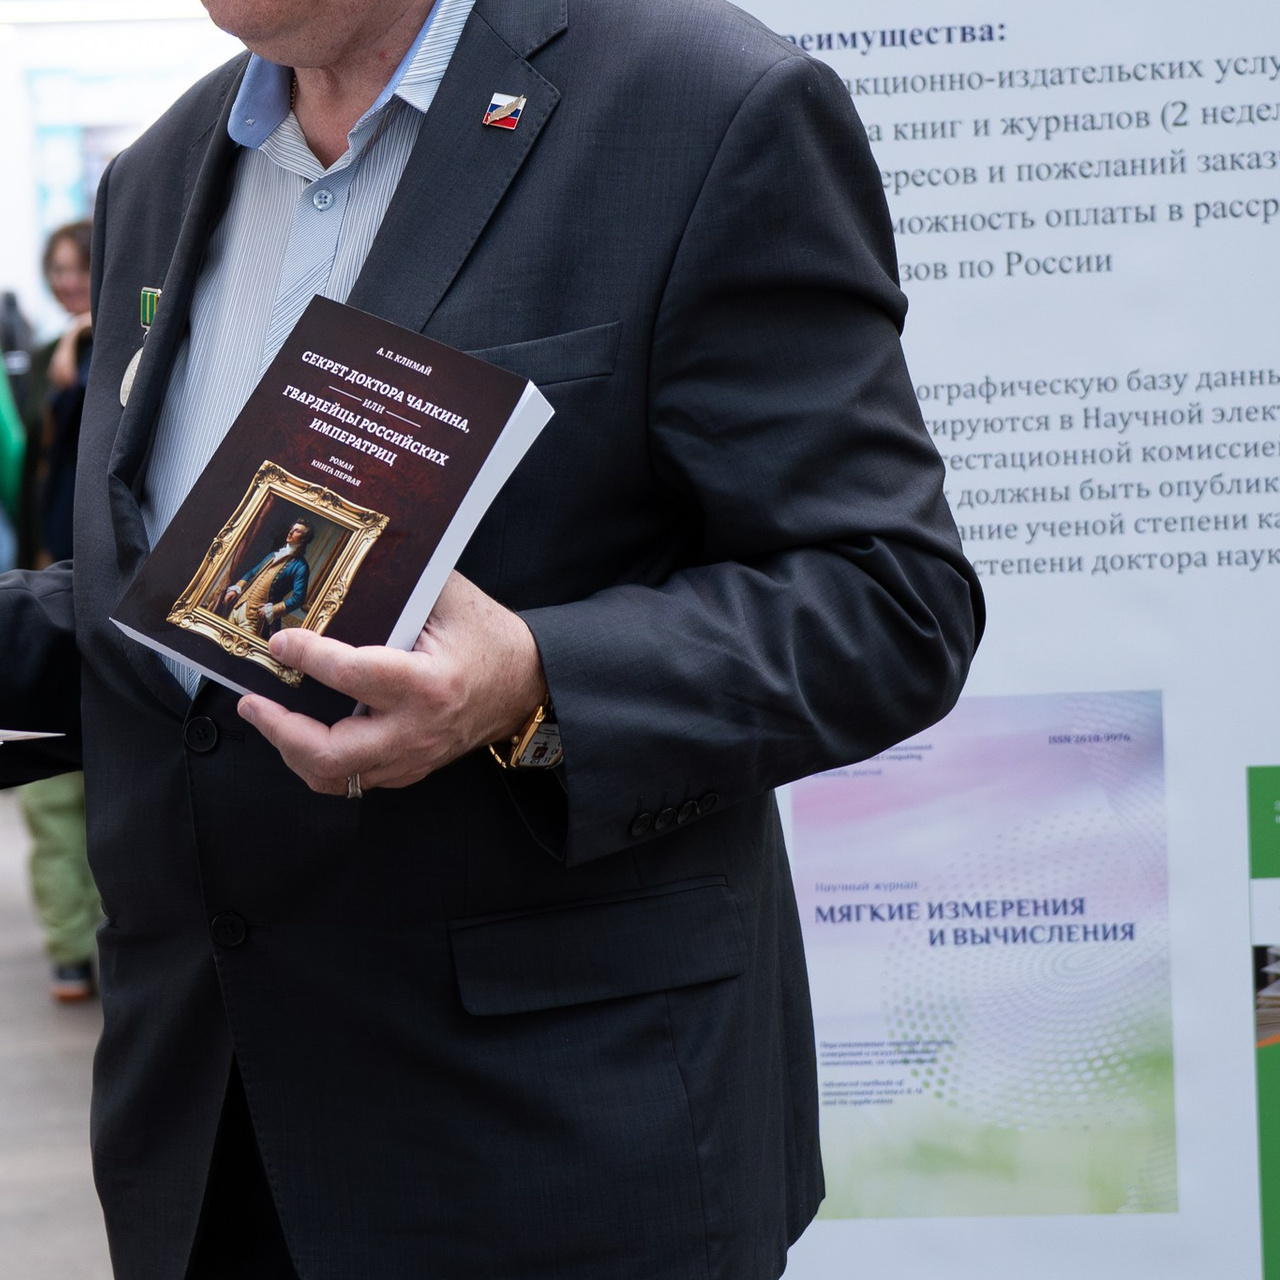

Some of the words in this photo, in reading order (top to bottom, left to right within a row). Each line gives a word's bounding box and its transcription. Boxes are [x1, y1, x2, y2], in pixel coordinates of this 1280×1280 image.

[893, 120, 962, 142] книг
[973, 118, 990, 137] и
[1001, 109, 1150, 141] журналов
[1160, 100, 1188, 134] (2
[989, 165, 1005, 183] и
[1017, 148, 1186, 183] пожеланий
[1197, 149, 1280, 173] заказ
[1045, 202, 1157, 229] оплаты
[1168, 202, 1183, 222] в
[958, 259, 994, 279] по
[1004, 251, 1113, 277] России
[376, 347, 384, 356] А.
[385, 351, 394, 360] П.
[394, 354, 432, 376] КЛИМАЙ
[301, 351, 349, 378] СЕКРЕТ
[345, 370, 404, 403] ДОКТОРА
[406, 394, 470, 434] ЧАЛКИНА,
[916, 375, 1118, 406] ографическую
[1126, 368, 1188, 396] базу
[362, 399, 385, 414] ИЛИ
[926, 414, 1051, 442] ируются
[1059, 413, 1073, 430] в
[1082, 401, 1204, 434] Научной
[1211, 404, 1280, 424] элек
[282, 385, 360, 426] ГВАРДЕЙЦЫ
[358, 417, 450, 467] РОССИЙСКИХ
[309, 418, 398, 467] ИМПЕРАТРИЦ
[1141, 438, 1280, 463] комиссие
[311, 459, 334, 475] КНИГА
[333, 468, 362, 487] ПЕРВАЯ
[329, 456, 354, 472] РОМАН
[957, 484, 1070, 510] должны
[1079, 477, 1151, 501] быть
[1158, 472, 1280, 503] опублик
[1025, 512, 1124, 545] ученой
[1134, 512, 1247, 535] степени
[972, 554, 1083, 577] степени
[1091, 548, 1208, 576] доктора
[1216, 547, 1280, 572] наук
[814, 902, 920, 924] МЯГКИЕ
[927, 896, 1086, 920] ИЗМЕРЕНИЯ
[928, 927, 946, 947] И
[953, 921, 1136, 946] ВЫЧИСЛЕНИЯ
